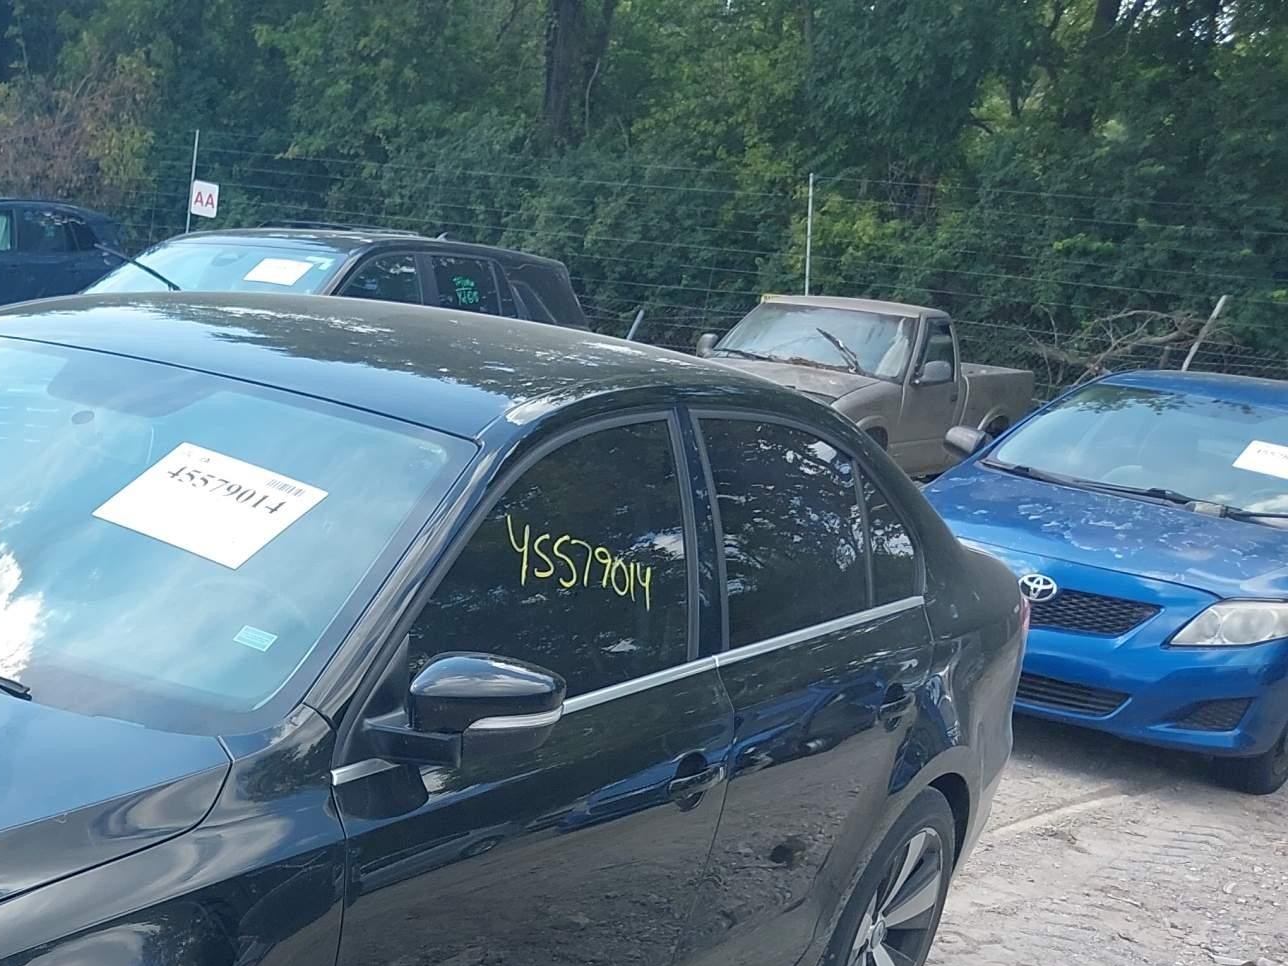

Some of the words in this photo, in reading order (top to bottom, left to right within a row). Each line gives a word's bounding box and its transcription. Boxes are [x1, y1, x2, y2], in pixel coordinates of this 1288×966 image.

[194, 191, 215, 209] AA
[167, 466, 287, 514] 45579014
[505, 512, 652, 612] 45579014
